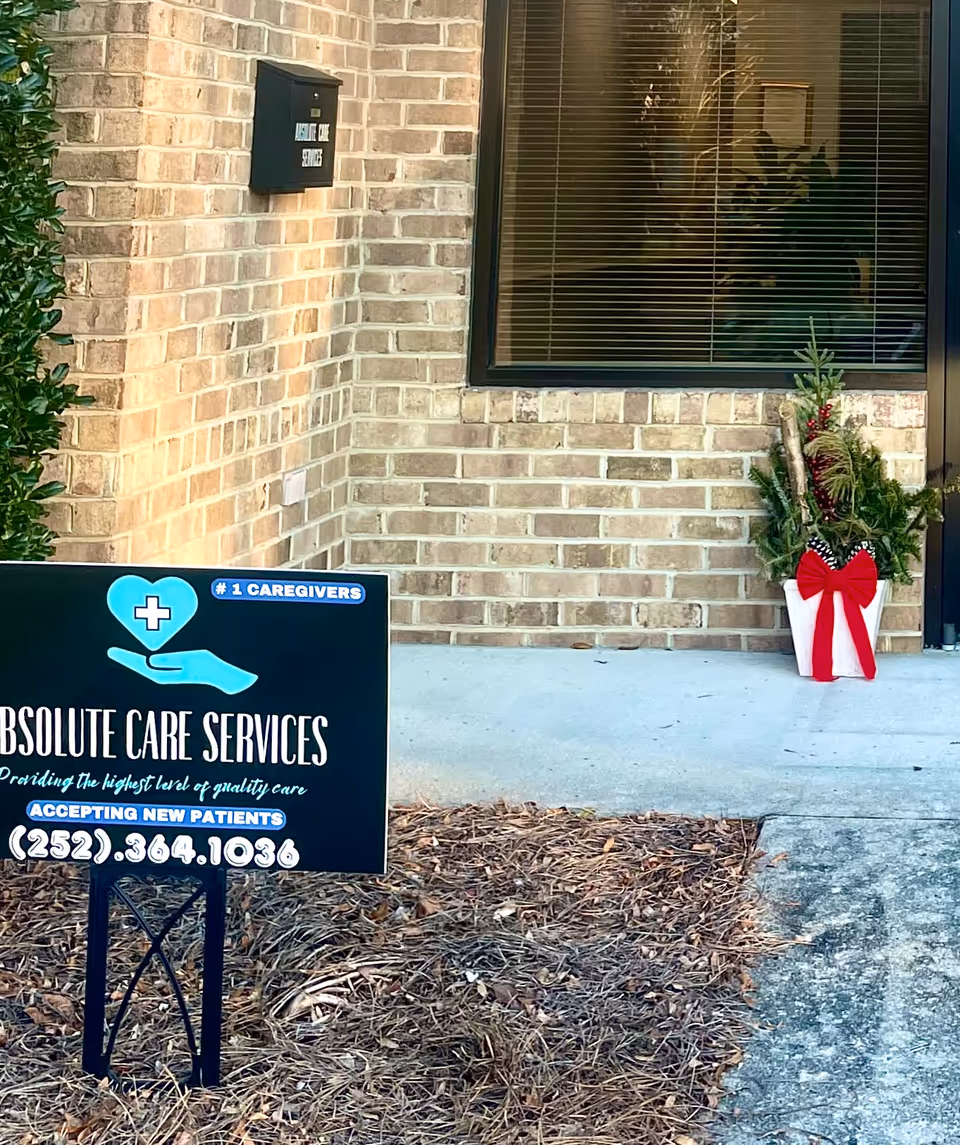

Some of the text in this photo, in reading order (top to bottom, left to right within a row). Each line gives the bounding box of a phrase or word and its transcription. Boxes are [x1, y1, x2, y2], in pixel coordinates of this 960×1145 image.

[216, 582, 362, 600] # 1 CAREGIVERS
[0, 706, 329, 766] BSOLUTE CARE SERVICES
[76, 772, 101, 789] the
[102, 773, 153, 795] highest
[155, 775, 190, 793] level
[192, 780, 210, 801] of
[271, 784, 308, 796] care
[29, 804, 284, 826] ACCEPTING NEW PATIENTS
[9, 825, 300, 869] (252).364.1036
